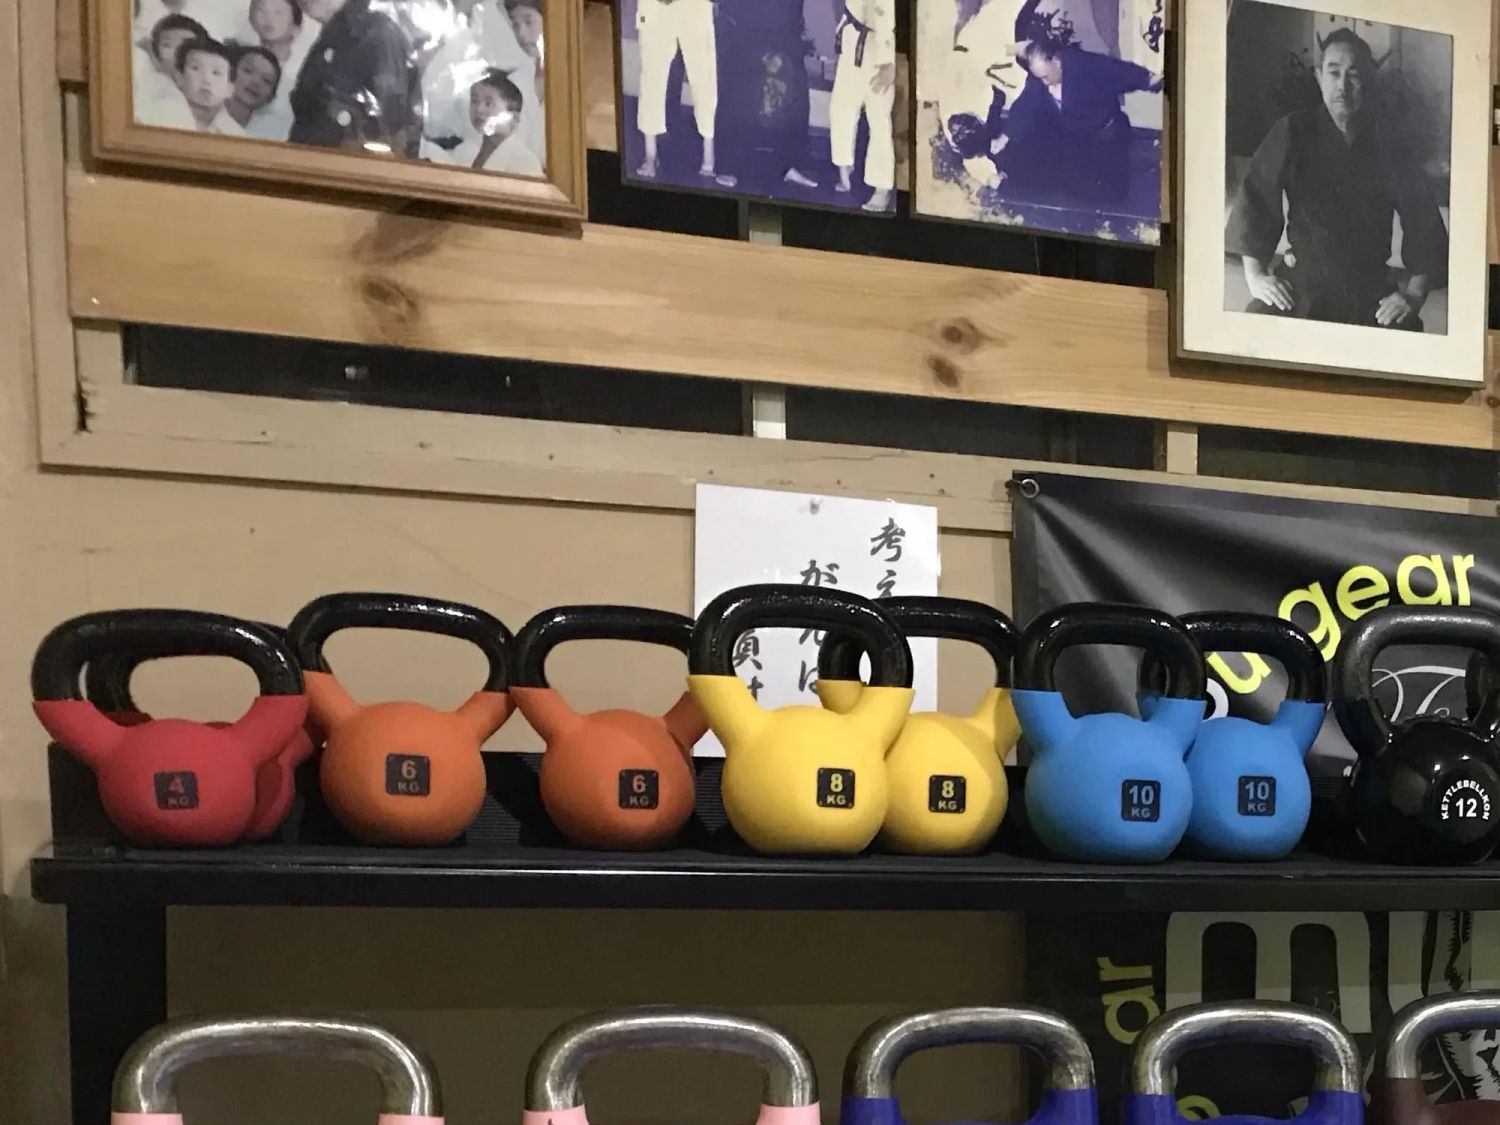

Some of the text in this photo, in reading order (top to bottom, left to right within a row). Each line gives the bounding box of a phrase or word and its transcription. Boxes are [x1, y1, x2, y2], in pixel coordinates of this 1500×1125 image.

[401, 760, 417, 780] 6
[169, 776, 185, 793] 4
[397, 781, 420, 792] KG
[632, 775, 646, 793] 6
[829, 773, 843, 792] 8
[941, 780, 955, 798] 8
[1245, 782, 1270, 801] 10
[630, 796, 649, 806] KG
[826, 795, 846, 805] KG
[1129, 785, 1154, 806] 10
[1441, 780, 1490, 820] KETTLEBELLKON
[938, 800, 958, 811] KG
[1131, 808, 1151, 819] KG
[1247, 803, 1267, 813] KG
[1455, 798, 1477, 817] 12
